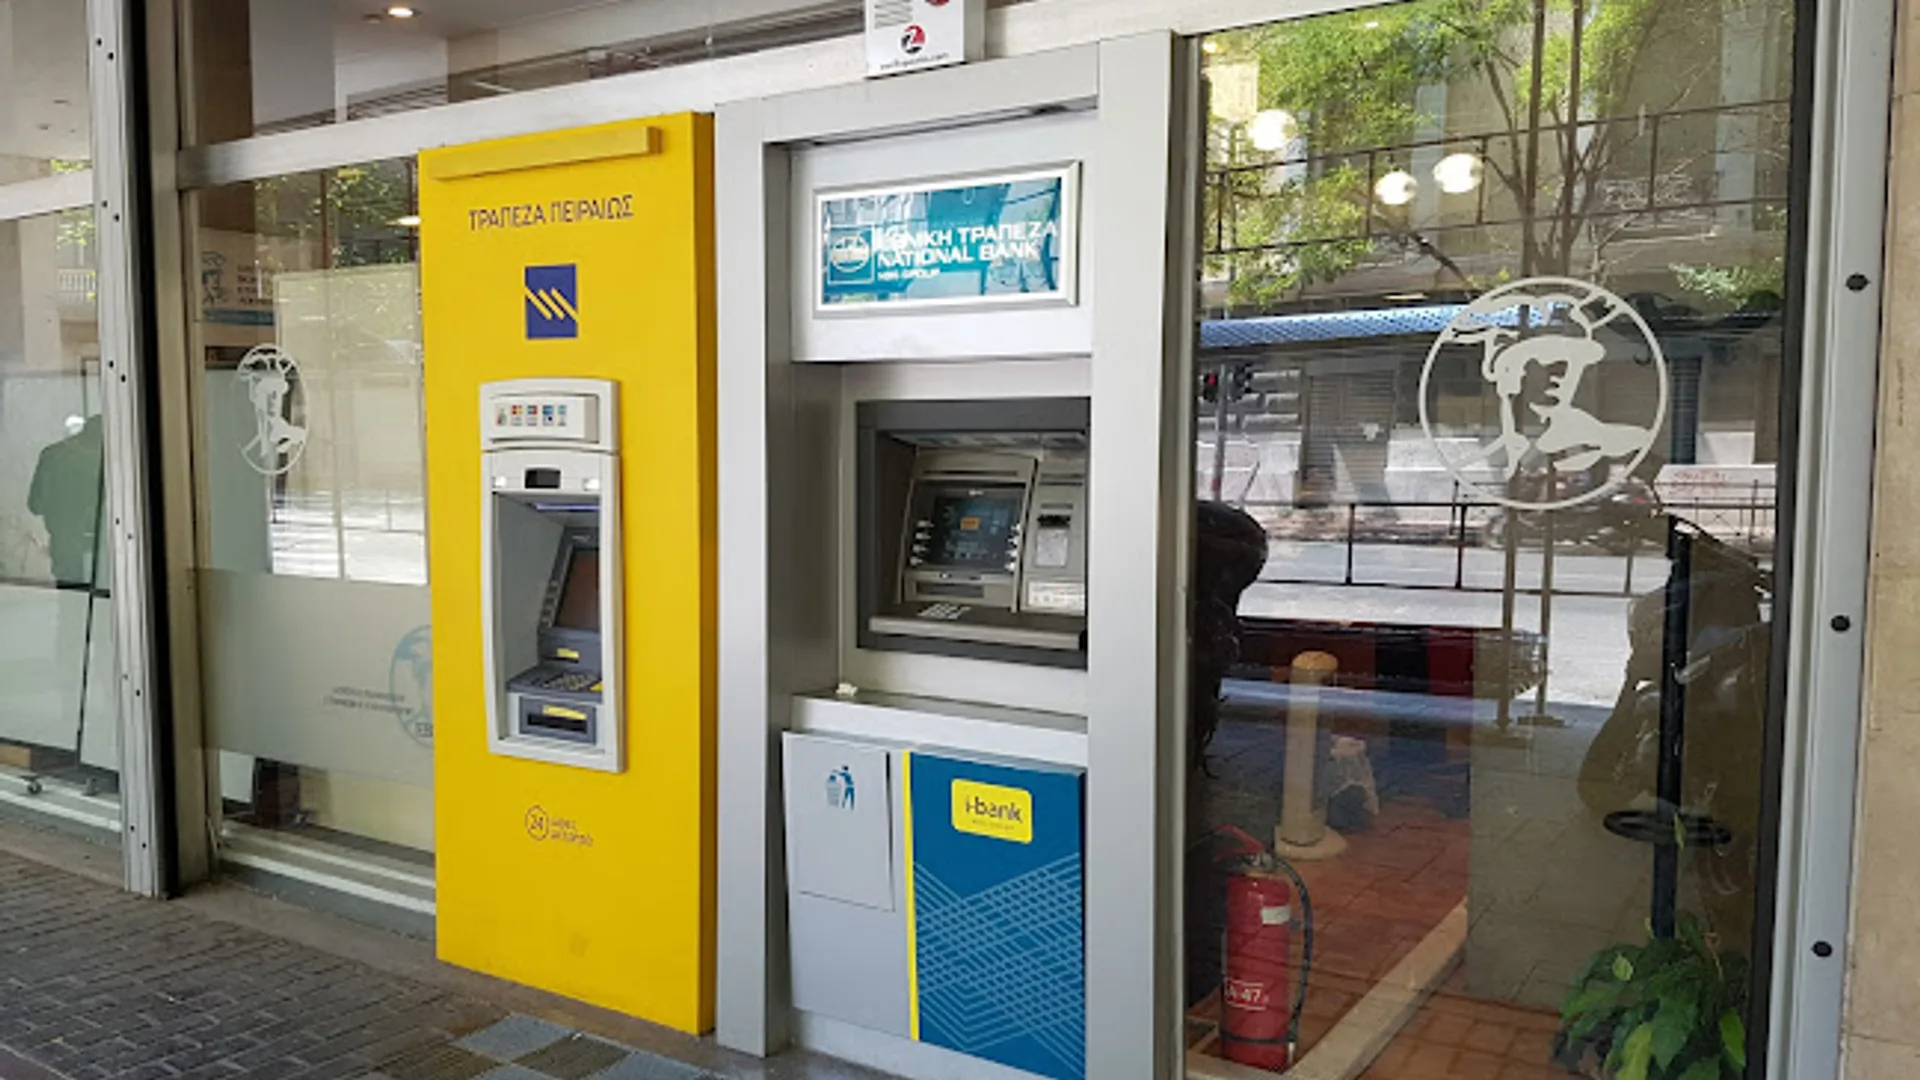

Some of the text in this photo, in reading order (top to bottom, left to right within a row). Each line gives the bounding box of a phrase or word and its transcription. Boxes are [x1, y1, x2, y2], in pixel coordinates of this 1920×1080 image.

[469, 194, 634, 231] ΤΡΑΠΕΖΑ ΠΕΙΡΑΙΩΣ
[957, 220, 1057, 245] ΤΡΑΠΕΖΑ
[877, 238, 1040, 269] NATIONAL BANK
[965, 794, 1024, 825] i-bank
